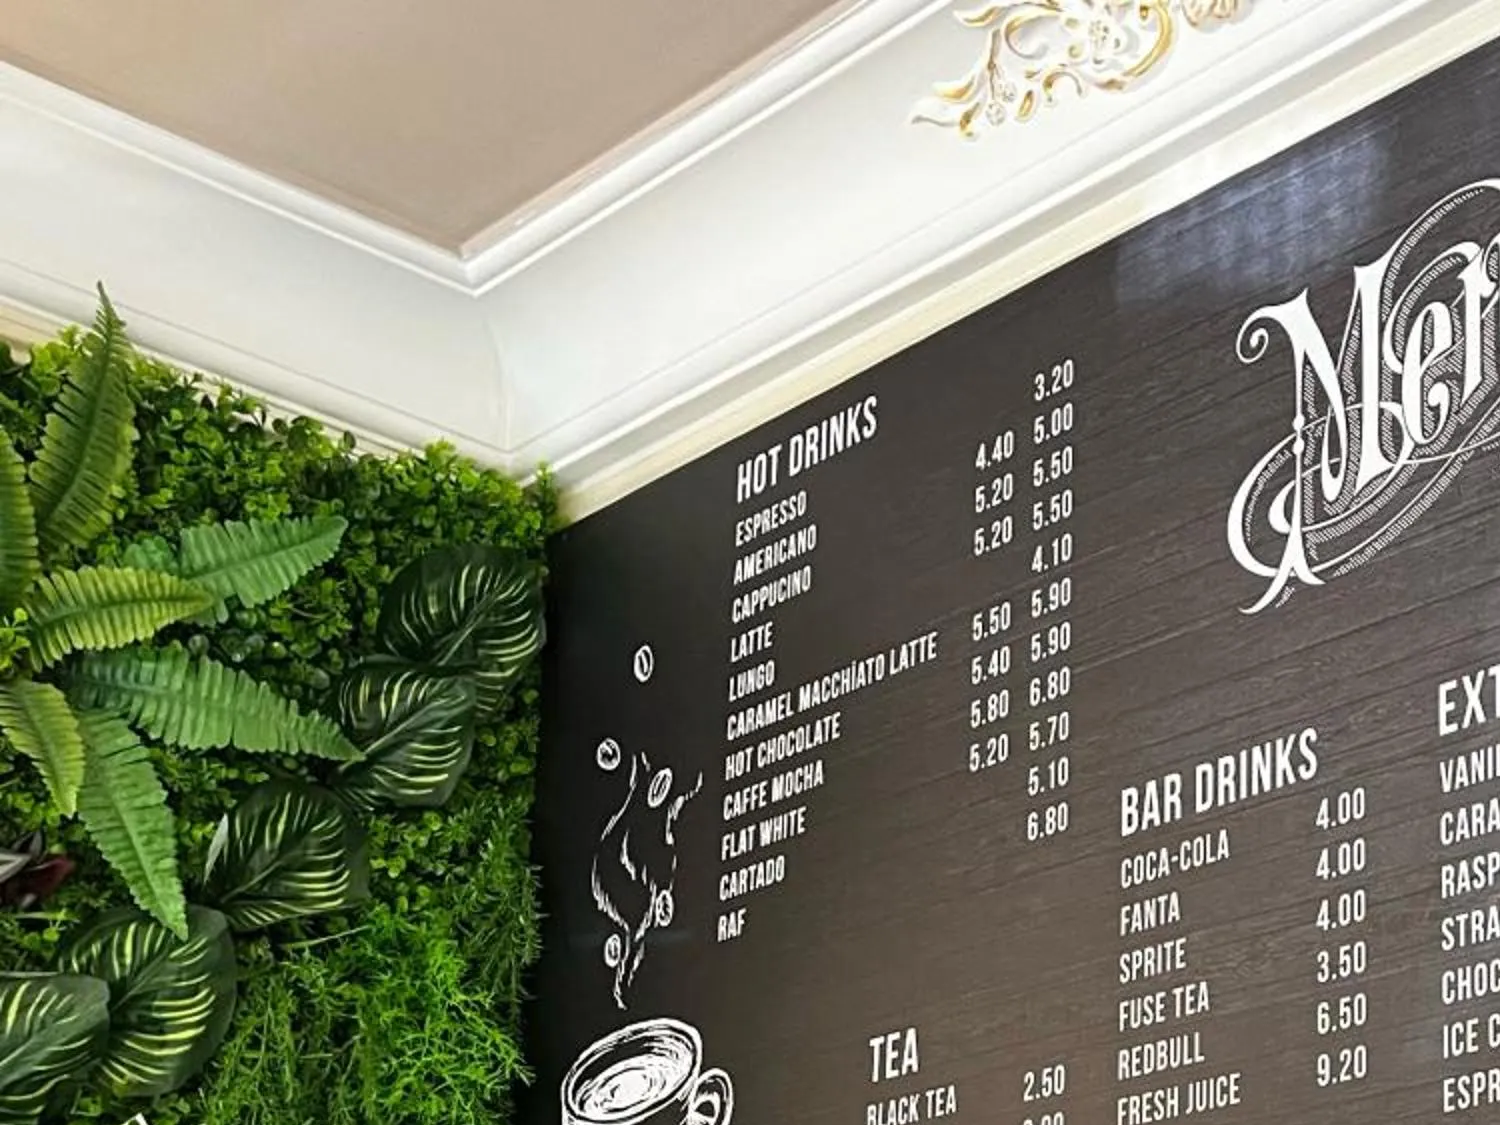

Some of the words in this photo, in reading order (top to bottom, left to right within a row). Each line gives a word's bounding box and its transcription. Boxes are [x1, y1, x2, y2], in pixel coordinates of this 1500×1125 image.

[1034, 359, 1074, 401] 3.20
[1033, 402, 1073, 445] 5.00
[737, 444, 783, 504] HOT
[789, 395, 877, 477] DRINKS
[975, 430, 1014, 470] 4.40
[1033, 445, 1073, 487] 5.50
[975, 473, 1014, 513] 5.20
[1032, 489, 1073, 531] 5.50
[735, 490, 807, 547] ESPRESSO
[973, 515, 1013, 557] 5.20
[733, 524, 817, 586] AMERICANO
[1031, 533, 1073, 573] 4.10
[731, 565, 811, 624] CAPPUCINO
[1031, 577, 1072, 619] 5.90
[730, 621, 773, 663] LATTE
[972, 601, 1011, 642] 5.50
[1030, 621, 1071, 663] 5.90
[727, 691, 794, 741] CARAMEL
[889, 631, 938, 676] LATTE
[729, 659, 775, 702] LUNGO
[971, 645, 1011, 685] 5.40
[1029, 665, 1071, 707] 6.80
[970, 689, 1009, 729] 5.80
[725, 746, 754, 781] HOT
[757, 711, 841, 768] CHOCOLATE
[1029, 711, 1070, 751] 5.70
[969, 733, 1009, 773] 5.20
[723, 780, 768, 821] CAFFE
[771, 759, 824, 803] MOCHA
[1027, 756, 1069, 797] 5.10
[1121, 772, 1182, 837] BAR
[1195, 727, 1318, 814] DRINKS
[1027, 801, 1069, 841] 6.80
[1315, 787, 1366, 830] 4.00
[721, 824, 756, 861] FLAT
[759, 806, 807, 847] WHITE
[719, 855, 785, 901] CARTADO
[1120, 828, 1230, 889] COCA-COLA
[1315, 837, 1366, 881] 4.00
[717, 908, 747, 942] RAF
[1120, 891, 1181, 937] FANTA
[1315, 889, 1366, 931] 4.00
[1119, 937, 1187, 985] SPRITE
[1316, 940, 1367, 983] 3.50
[1119, 991, 1167, 1033] FUSE
[1171, 980, 1210, 1019] TEA
[1317, 992, 1367, 1035] 6.50
[869, 1027, 919, 1083] TEA
[1117, 1031, 1205, 1081] REDBULL
[1443, 1017, 1479, 1059] ICE
[1023, 1064, 1066, 1102] 2.50
[1316, 1044, 1367, 1087] 9.20
[925, 1084, 957, 1119] TEA
[1185, 1072, 1241, 1115] JUICE
